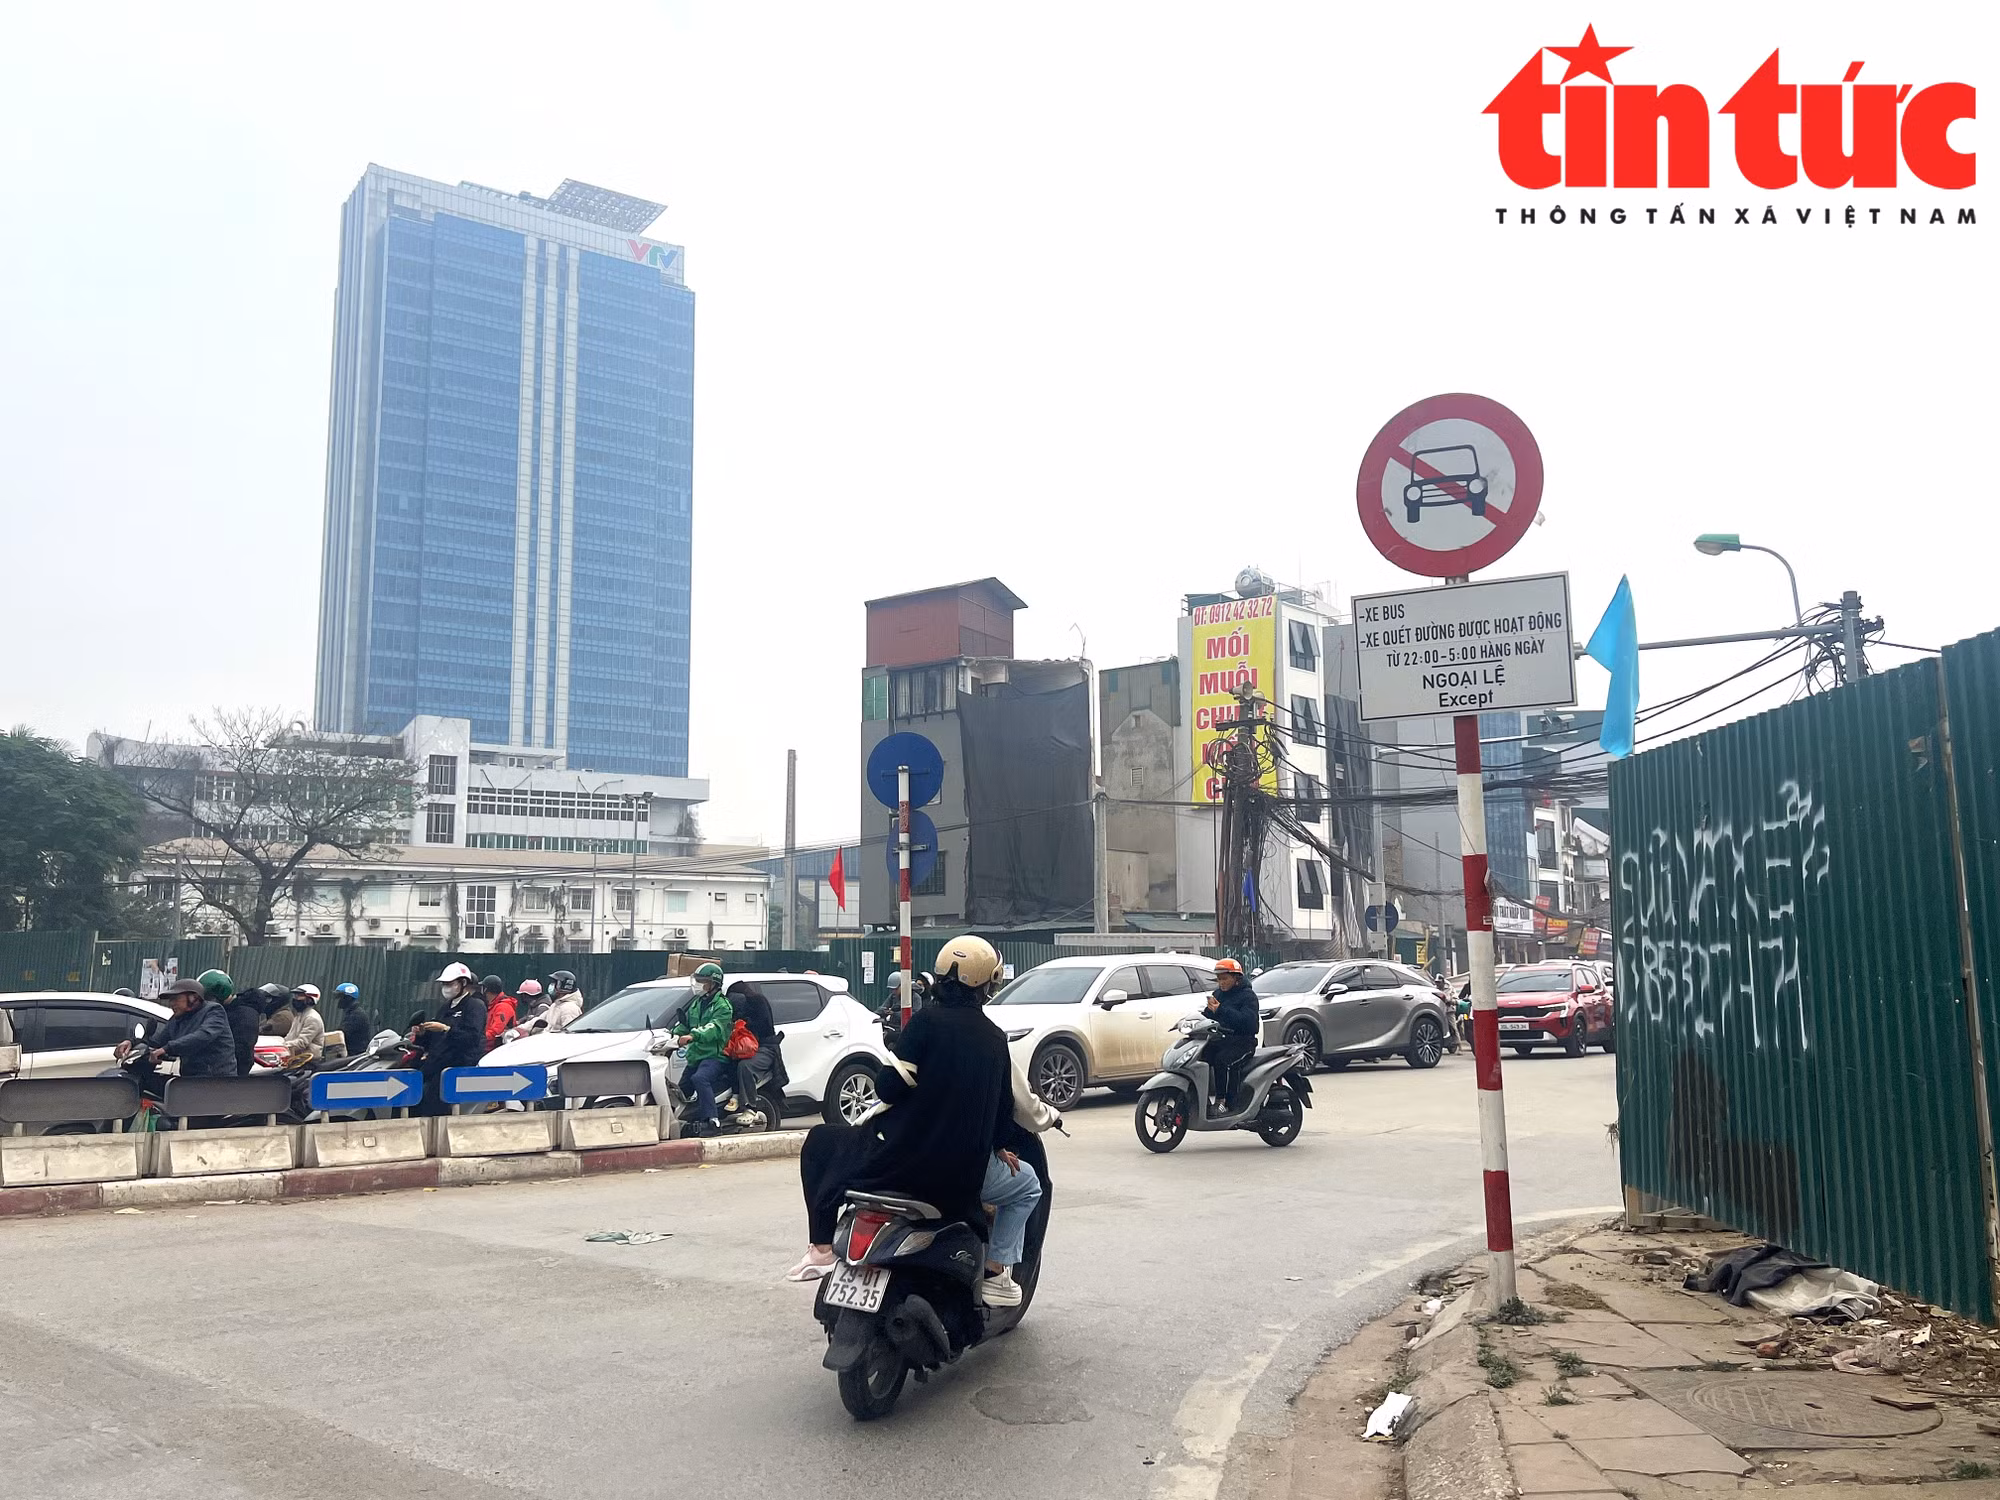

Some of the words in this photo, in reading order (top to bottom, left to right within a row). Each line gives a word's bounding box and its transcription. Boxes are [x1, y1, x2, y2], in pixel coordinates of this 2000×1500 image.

[628, 238, 679, 269] VTV
[1209, 602, 1231, 624] 0912
[1233, 601, 1244, 621] 42
[1247, 599, 1259, 619] 32
[1261, 597, 1273, 616] 72
[1382, 603, 1405, 620] BUS
[1383, 625, 1411, 645] QUÉT
[1415, 620, 1455, 642] ĐƯỜNG
[1458, 618, 1491, 639] ĐƯỢC
[1494, 615, 1525, 636] HOẠT
[1529, 611, 1562, 632] ĐỘNG
[1207, 626, 1249, 660] MỐI
[1387, 650, 1400, 667] TỪ
[1480, 641, 1511, 659] HÀNG
[1515, 638, 1545, 656] NGÀY
[1200, 661, 1258, 695] MUỖI
[1422, 669, 1478, 690] NGOẠI
[1483, 664, 1506, 686] LỆ
[1438, 689, 1494, 708] Except
[829, 1283, 880, 1308] 752.35
